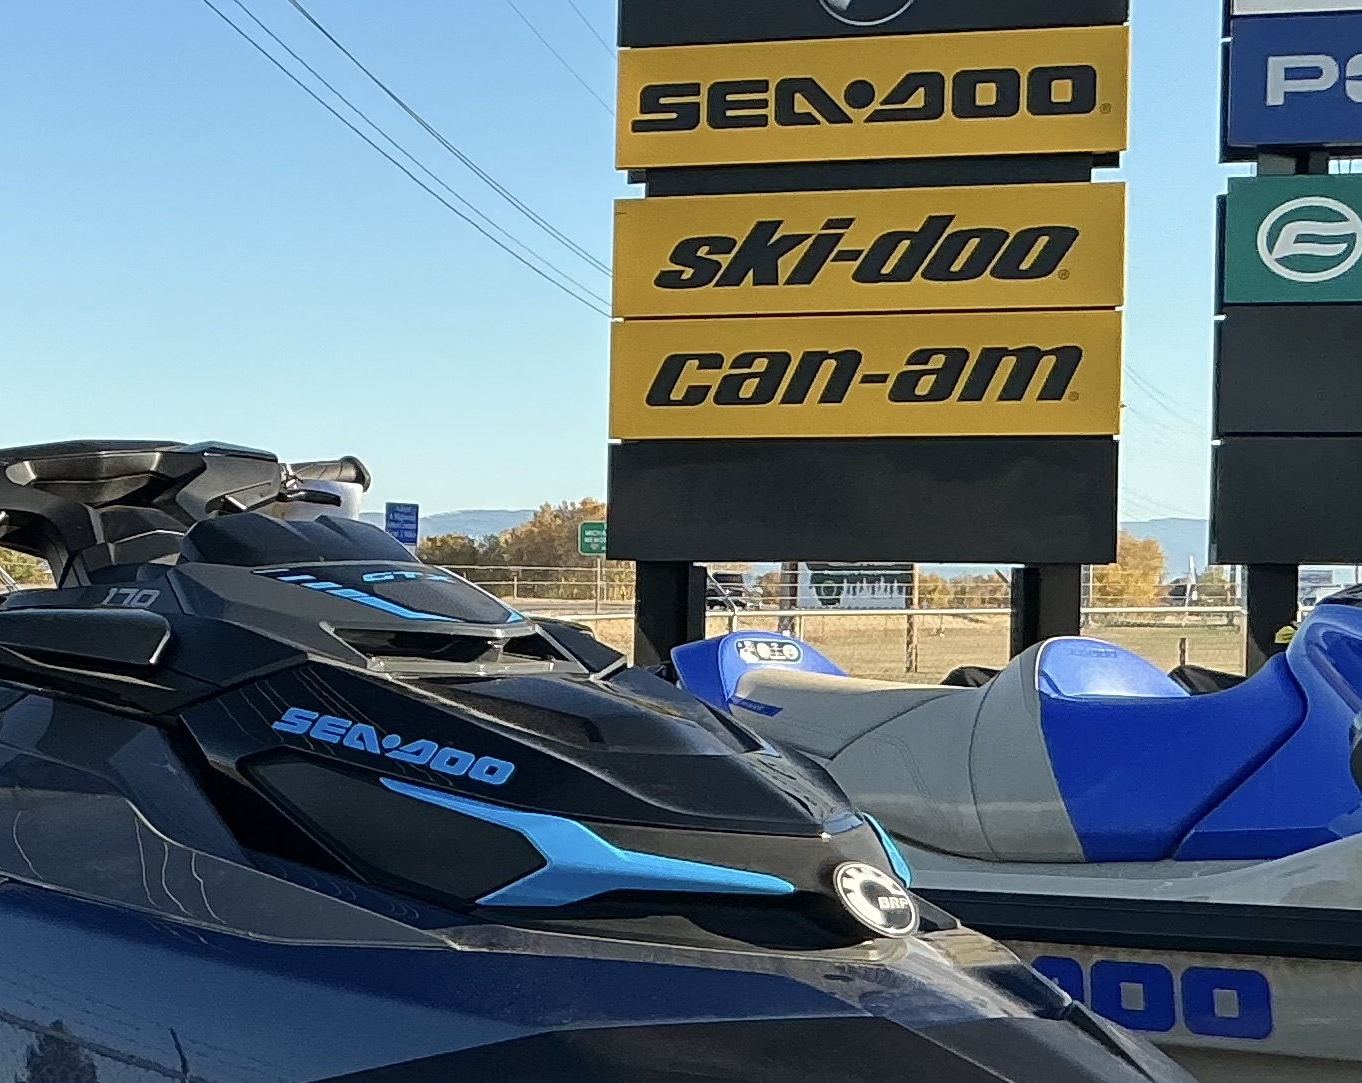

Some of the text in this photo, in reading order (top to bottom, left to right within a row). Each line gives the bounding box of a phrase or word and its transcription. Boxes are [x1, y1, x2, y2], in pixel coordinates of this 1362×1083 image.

[1265, 52, 1362, 107] P
[652, 214, 1081, 289] ski-doo
[644, 344, 1084, 408] can-am
[100, 587, 161, 609] 170
[877, 896, 910, 910] BRP
